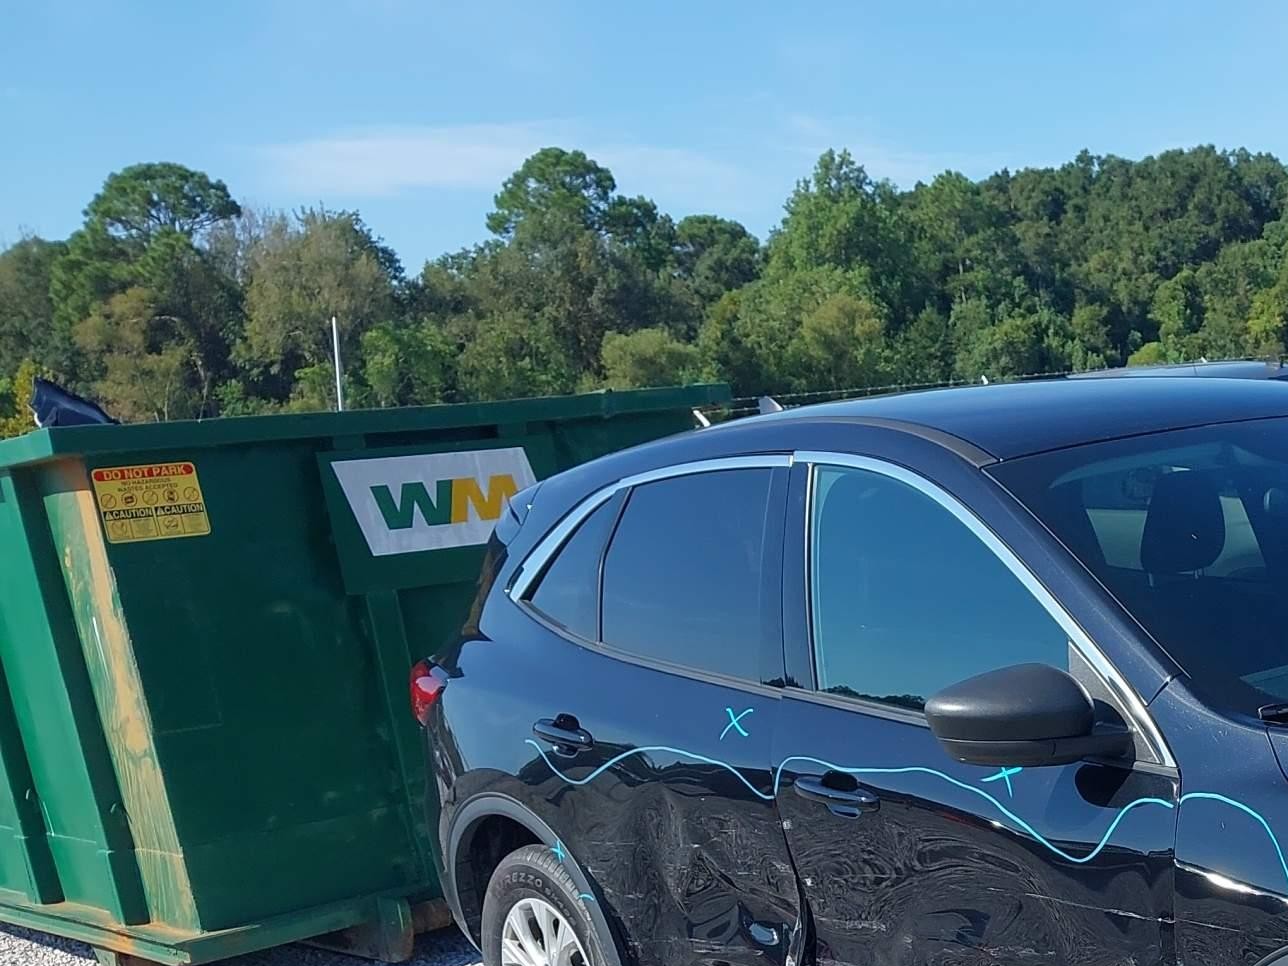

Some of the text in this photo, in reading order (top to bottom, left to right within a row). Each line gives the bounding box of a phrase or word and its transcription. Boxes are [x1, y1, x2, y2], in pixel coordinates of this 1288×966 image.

[103, 465, 186, 480] DO NOT PARK
[369, 474, 517, 530] WM
[112, 508, 152, 519] CAUTION
[164, 503, 203, 515] CAUTION
